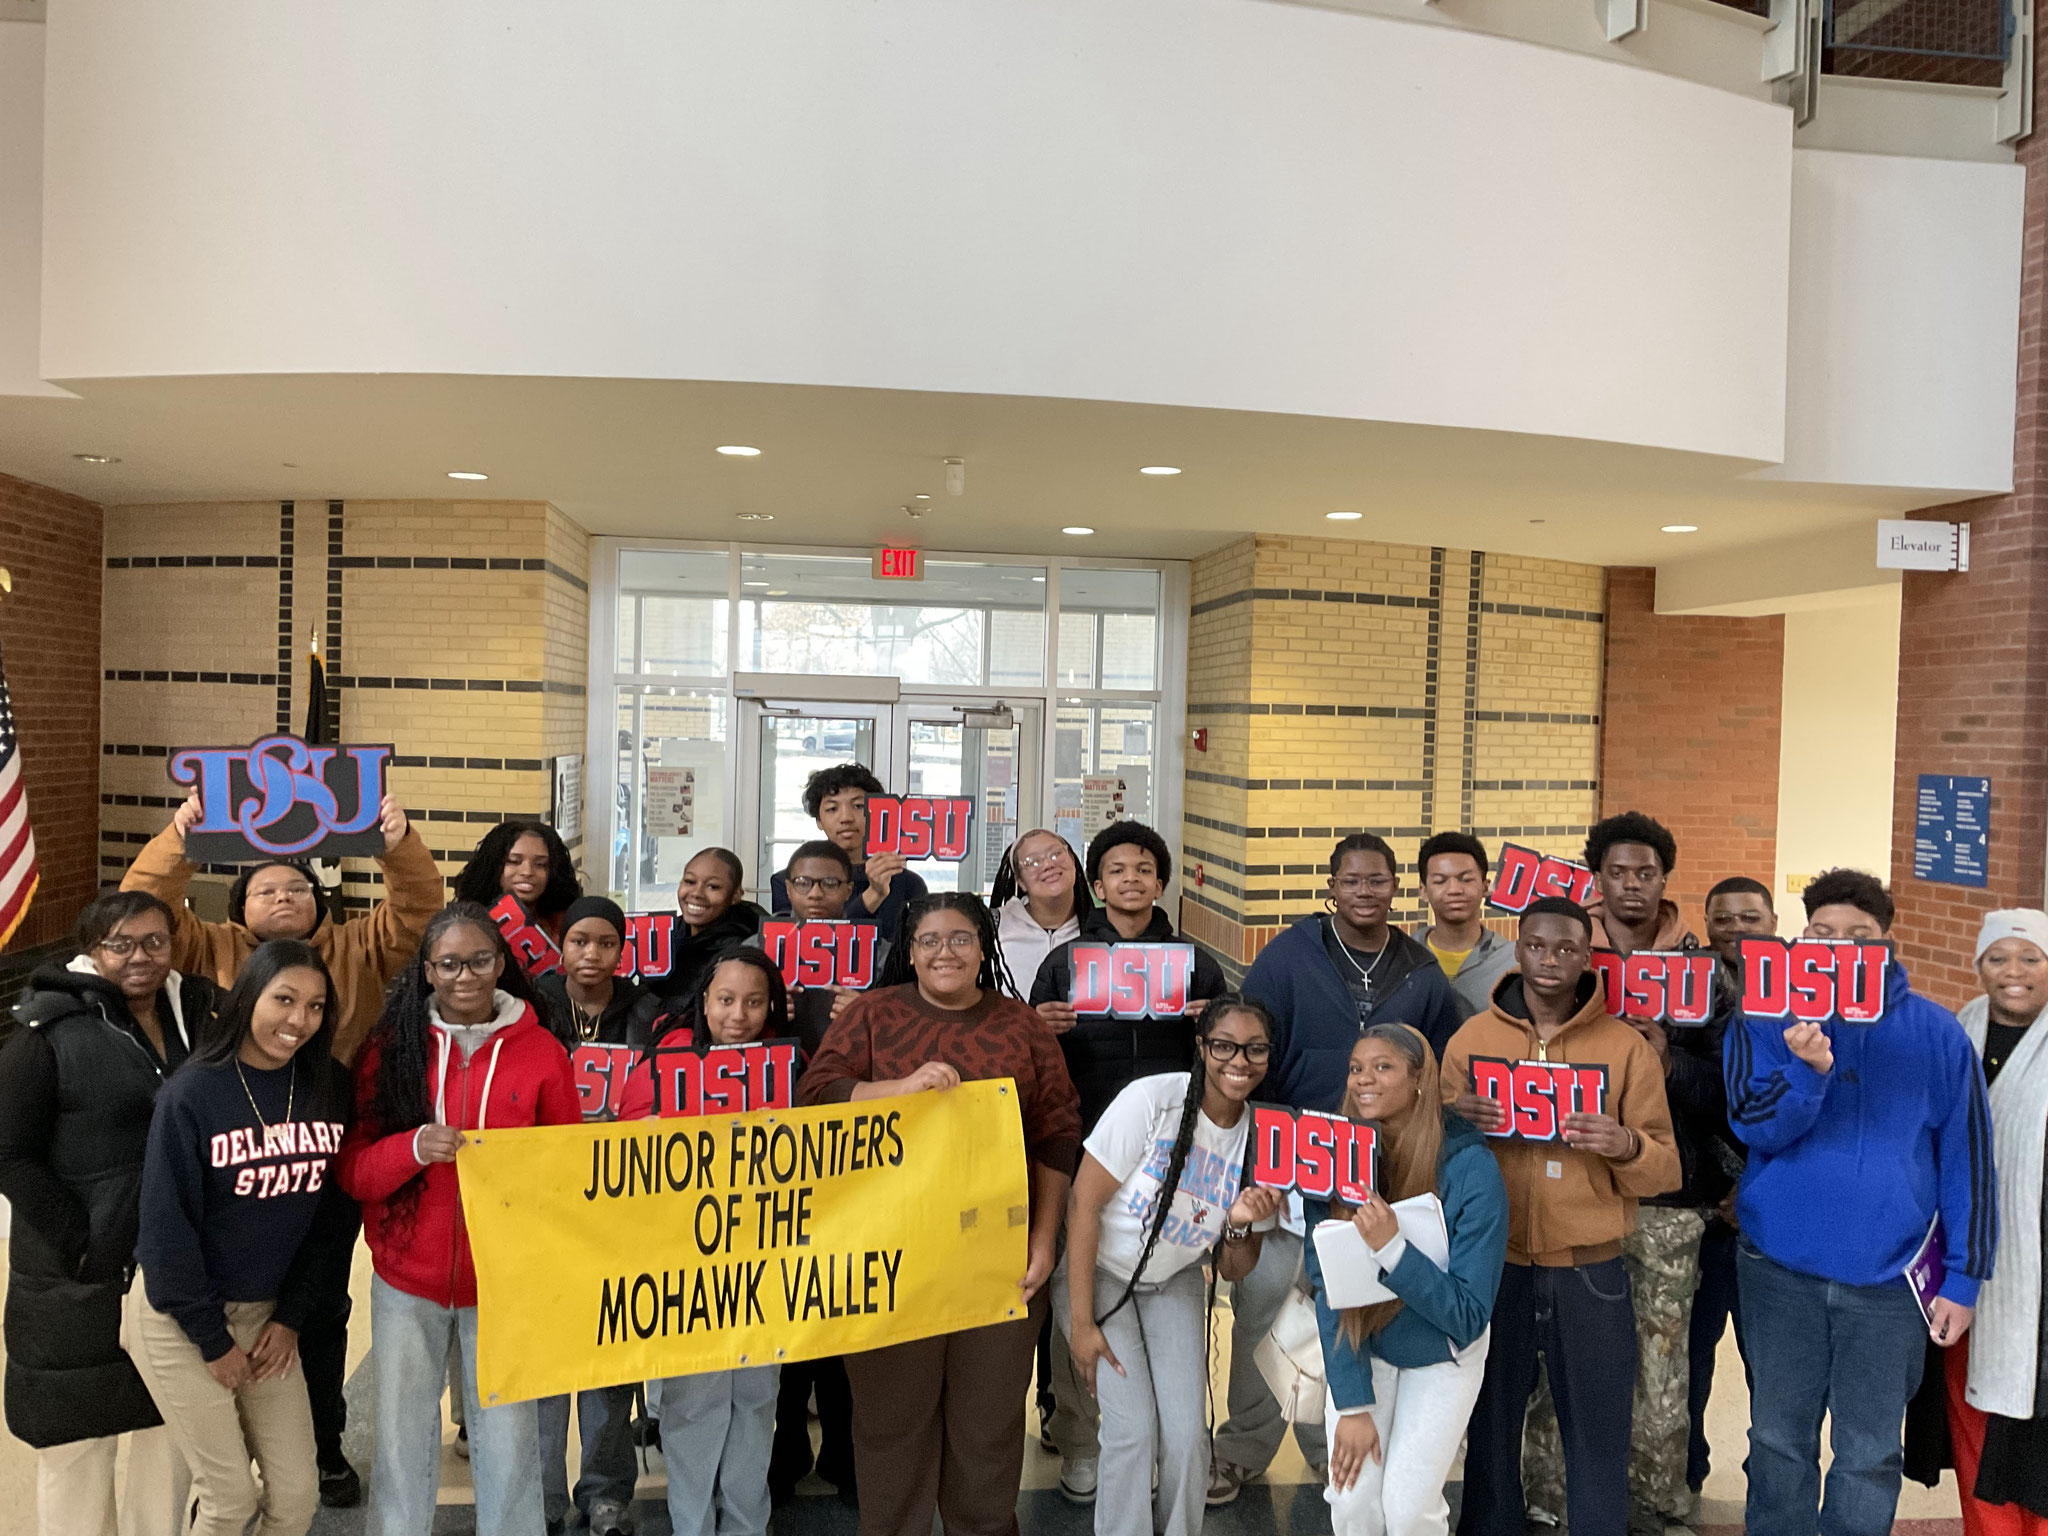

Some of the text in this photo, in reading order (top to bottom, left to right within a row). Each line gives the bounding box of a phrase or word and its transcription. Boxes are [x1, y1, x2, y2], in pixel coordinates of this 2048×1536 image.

[882, 549, 918, 577] EXIT
[1891, 534, 1942, 552] Elevator
[171, 737, 390, 855] DSU
[1949, 778, 1954, 790] 1
[1981, 780, 1989, 792] 2
[866, 797, 971, 859] DSU
[1945, 830, 1952, 842] 3
[1979, 833, 1986, 845] 4
[763, 921, 878, 989] DSU
[1073, 947, 1190, 1015] DSU
[1592, 953, 1715, 1023] DSU
[1741, 939, 1889, 1022] DSU
[655, 1044, 795, 1118] DSU
[1473, 1060, 1604, 1140] DSU
[234, 1159, 327, 1198] STATE
[584, 1110, 904, 1201] JUNIOR FRONTIERS
[1254, 1107, 1377, 1205] DSU
[694, 1187, 813, 1256] OF THE
[597, 1249, 903, 1346] MOHAWK VALLEY
